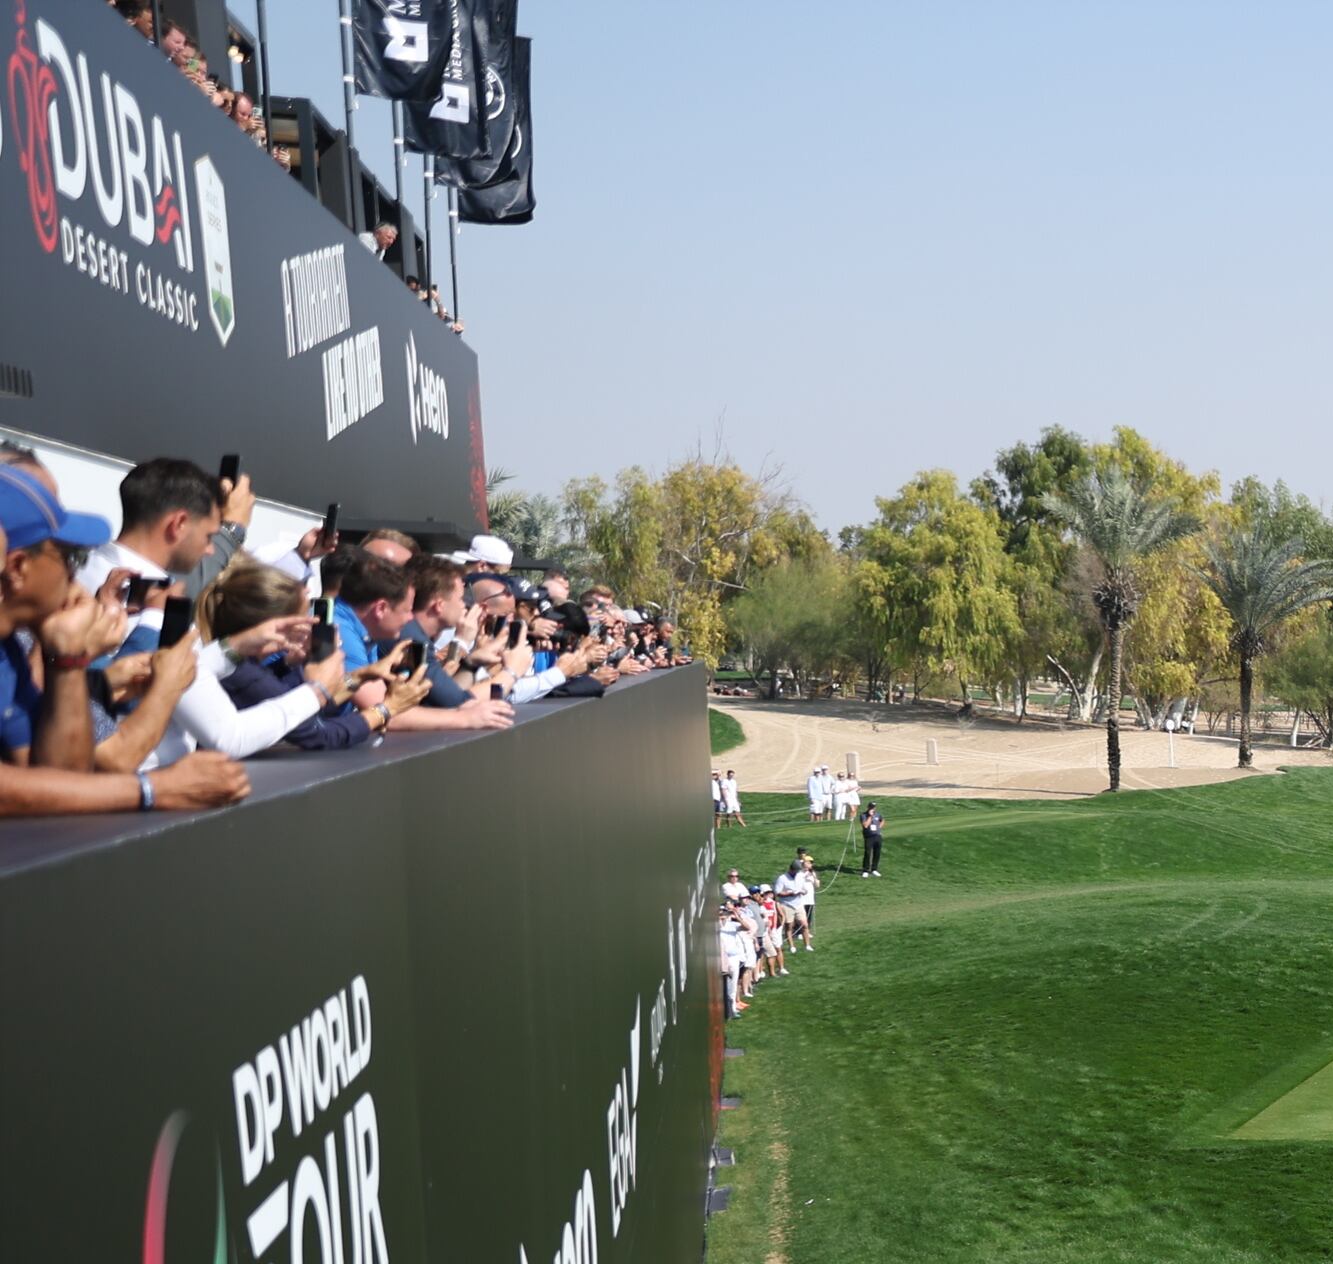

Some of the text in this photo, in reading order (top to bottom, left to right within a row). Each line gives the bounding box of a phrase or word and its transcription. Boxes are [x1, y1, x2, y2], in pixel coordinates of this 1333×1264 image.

[36, 17, 194, 274] DUBAI
[59, 216, 129, 295] DESERT
[135, 260, 199, 332] CLASSIC
[419, 362, 449, 440] Hero
[232, 975, 372, 1186] DP WORLD
